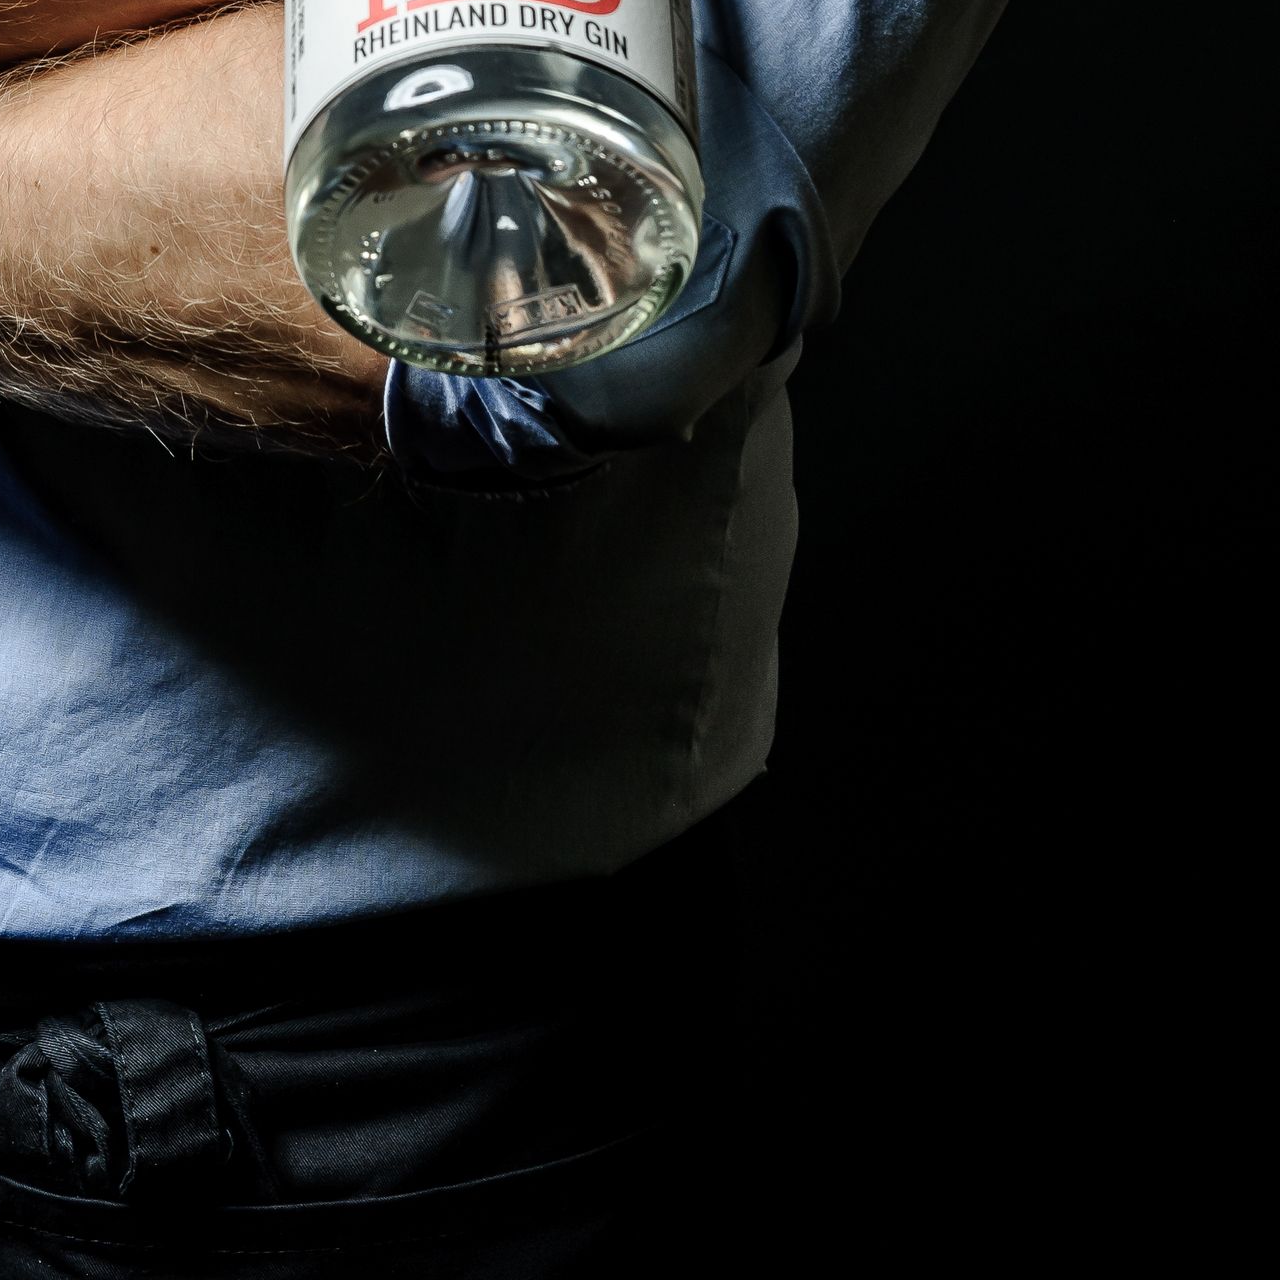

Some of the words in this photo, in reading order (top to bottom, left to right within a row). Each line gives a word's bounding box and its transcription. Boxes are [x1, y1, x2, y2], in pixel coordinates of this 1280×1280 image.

[353, 2, 508, 64] RHEINLAND
[519, 4, 574, 36] DRY
[585, 21, 629, 60] GIN
